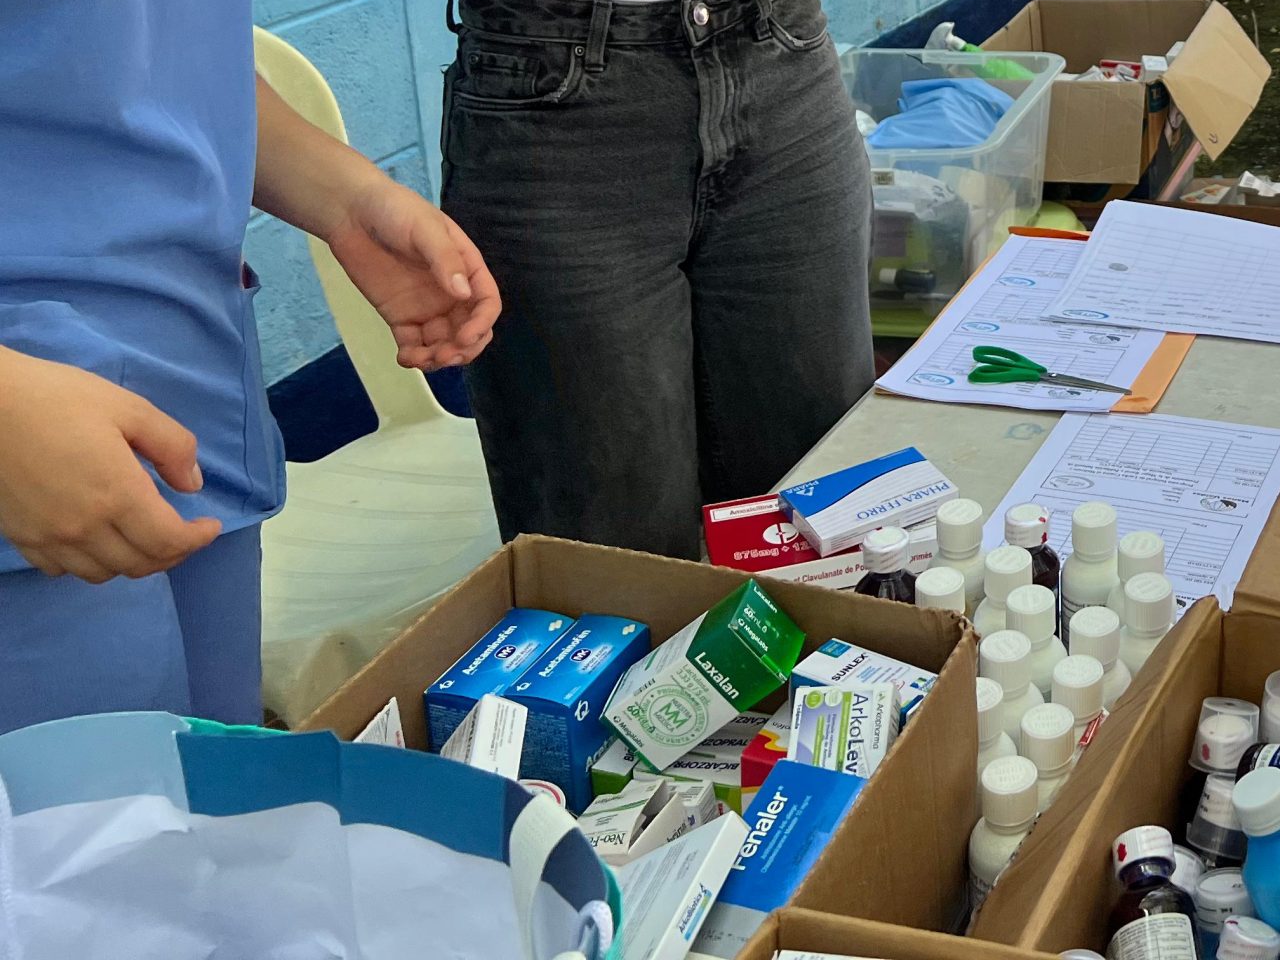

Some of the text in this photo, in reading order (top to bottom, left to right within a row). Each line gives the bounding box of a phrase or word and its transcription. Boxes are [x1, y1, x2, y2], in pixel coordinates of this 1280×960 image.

[856, 481, 951, 521] PHARA FERRO
[802, 569, 843, 584] Clavulanate
[844, 566, 854, 576] de
[462, 624, 519, 676] Acetaminofén
[499, 646, 515, 659] MK
[537, 628, 592, 678] Acetaminofén
[743, 625, 770, 652] Megalabs
[573, 649, 590, 662] MK
[832, 652, 868, 682] SUNLEX
[693, 650, 741, 700] Laxalan
[618, 721, 645, 748] Megalabs
[873, 704, 884, 749] Arkopharma
